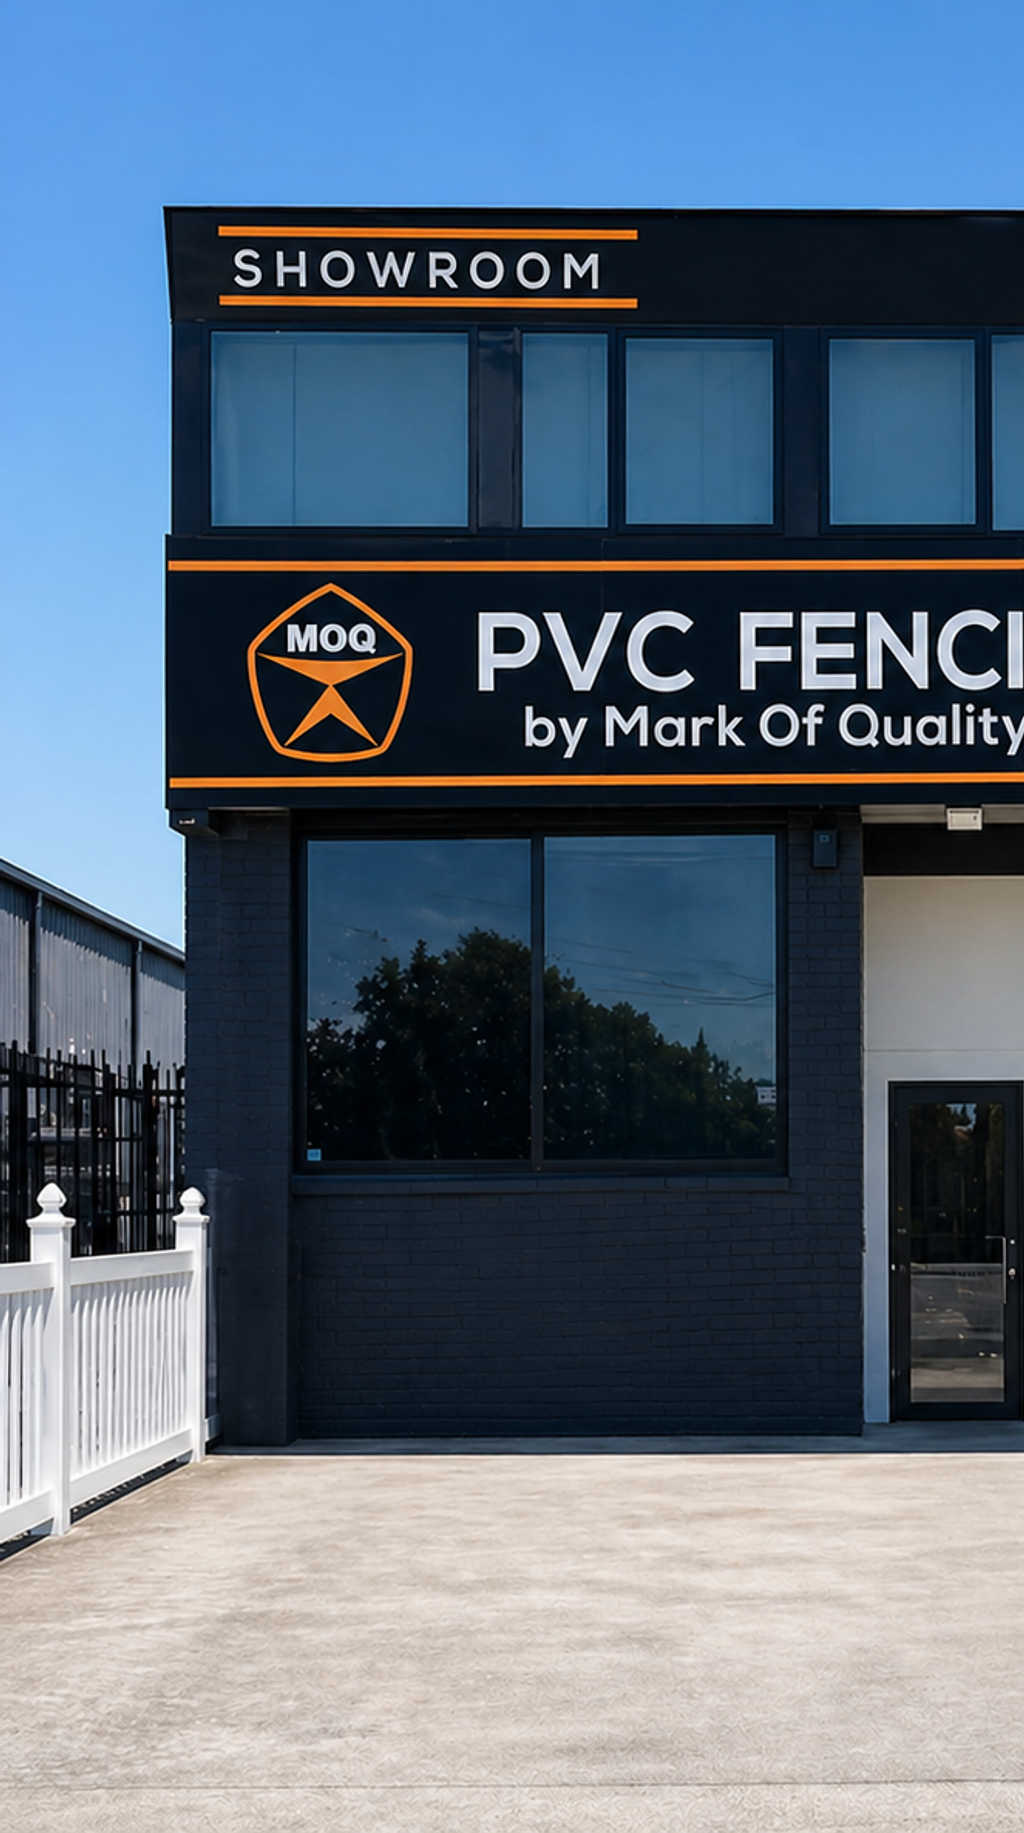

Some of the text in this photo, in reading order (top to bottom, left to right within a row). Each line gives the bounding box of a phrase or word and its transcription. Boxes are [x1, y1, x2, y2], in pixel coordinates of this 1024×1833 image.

[234, 248, 599, 290] SHOWROOM
[287, 623, 377, 655] MOQ
[478, 610, 695, 693] PVC
[525, 705, 589, 759] by
[605, 704, 746, 748] Mark
[759, 703, 825, 747] Of
